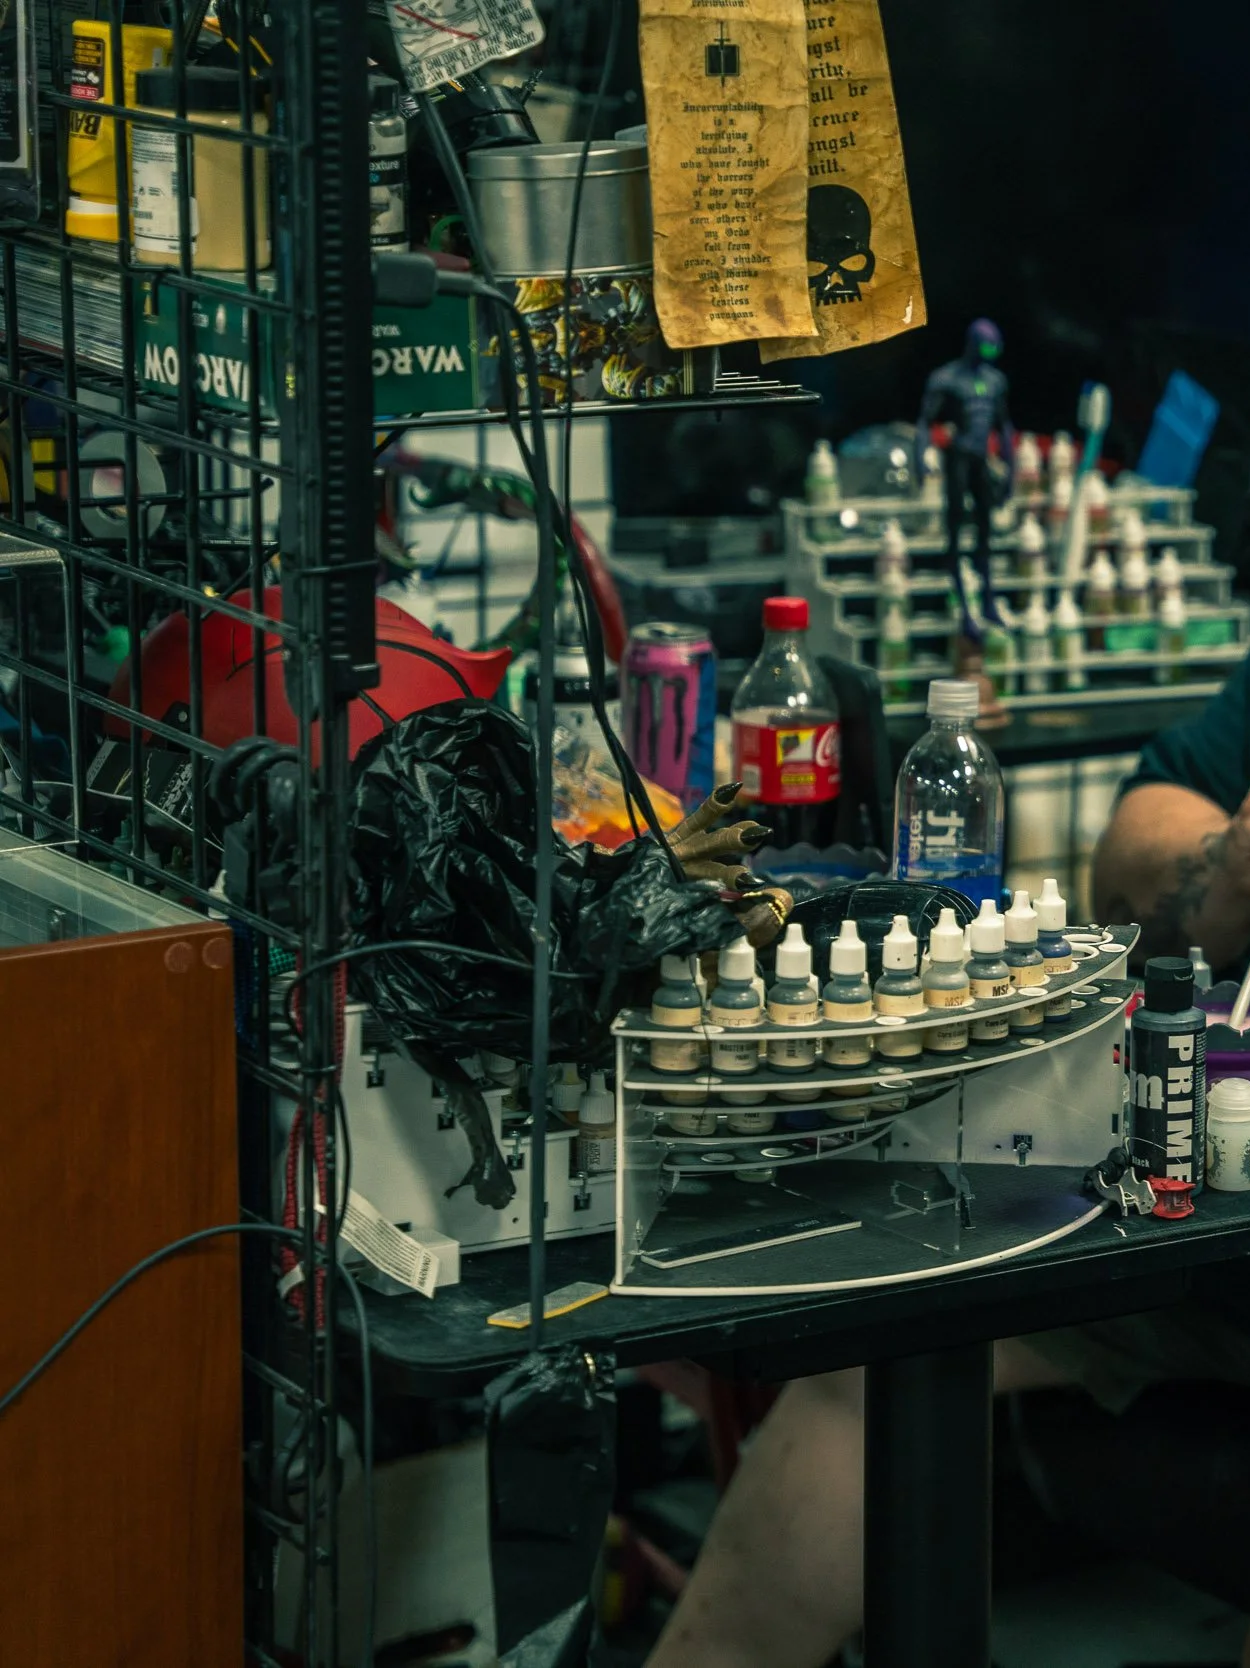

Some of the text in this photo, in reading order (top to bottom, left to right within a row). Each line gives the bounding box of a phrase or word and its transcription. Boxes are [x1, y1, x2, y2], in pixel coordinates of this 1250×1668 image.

[806, 16, 836, 30] ure
[807, 62, 852, 80] rity,
[810, 82, 868, 104] all be
[808, 130, 856, 154] ongst
[370, 160, 400, 171] exture
[808, 158, 846, 176] uilt.
[371, 344, 465, 377] WARC
[1166, 1034, 1195, 1184] PRIME
